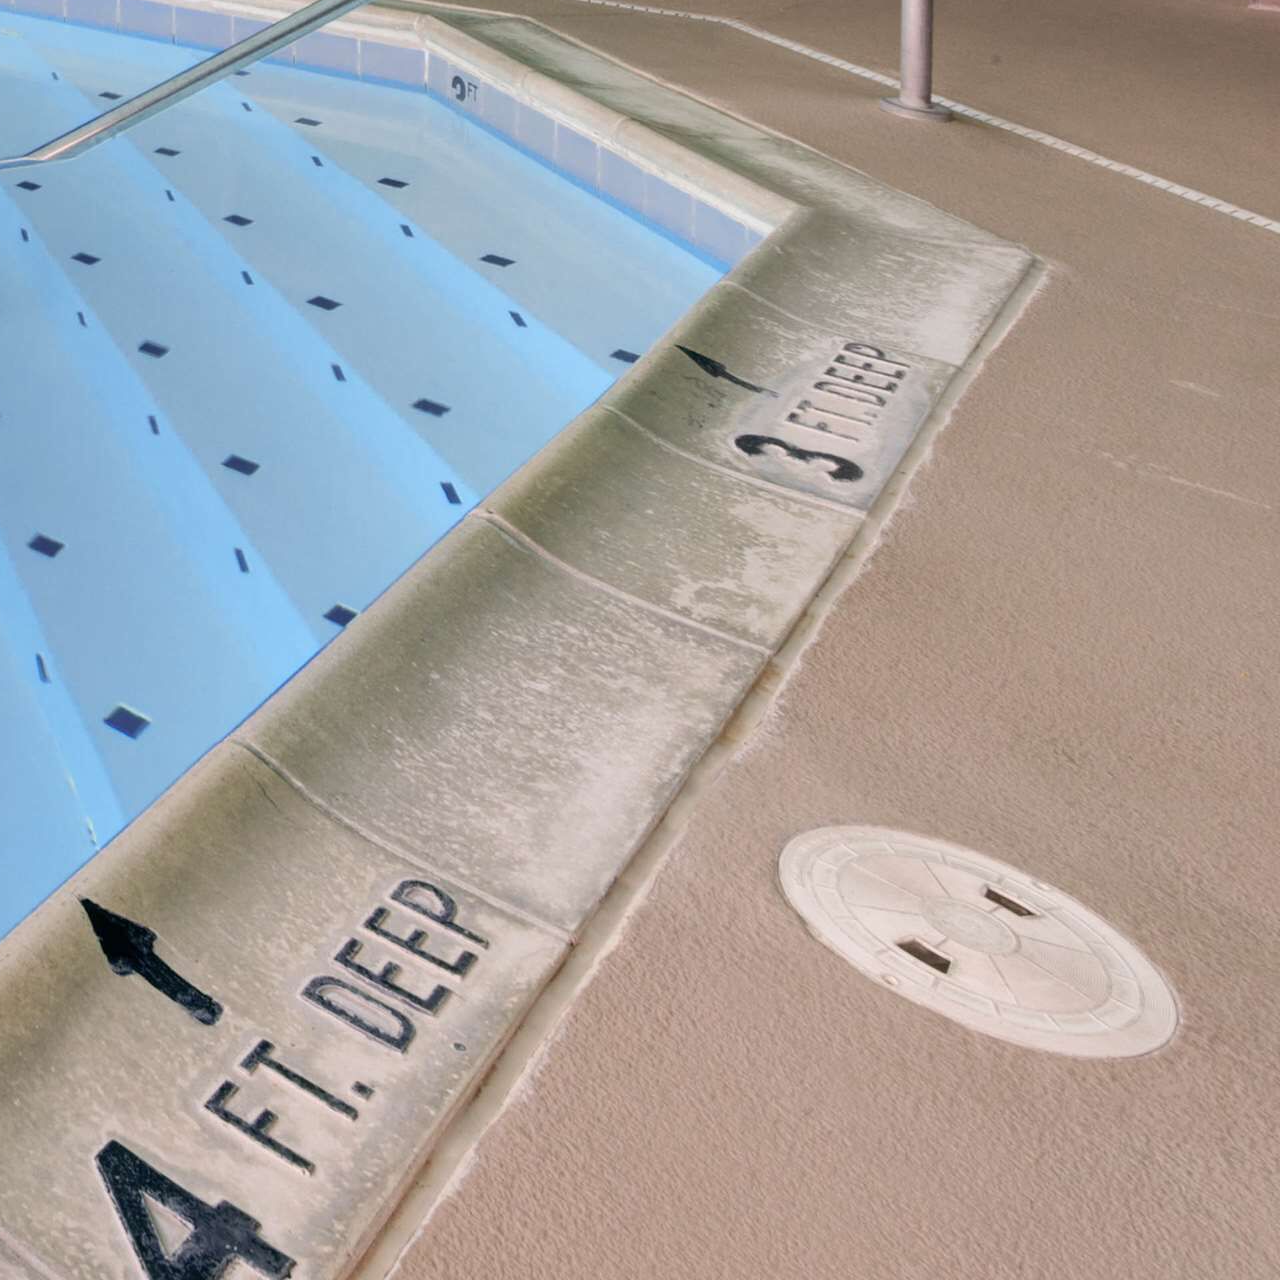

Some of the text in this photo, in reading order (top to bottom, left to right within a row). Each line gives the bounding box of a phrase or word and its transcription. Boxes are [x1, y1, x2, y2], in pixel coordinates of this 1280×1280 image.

[468, 82, 478, 102] FT
[734, 434, 864, 482] 3
[813, 342, 911, 407] DEEP
[95, 877, 490, 1280] 4 FT. DEEP
